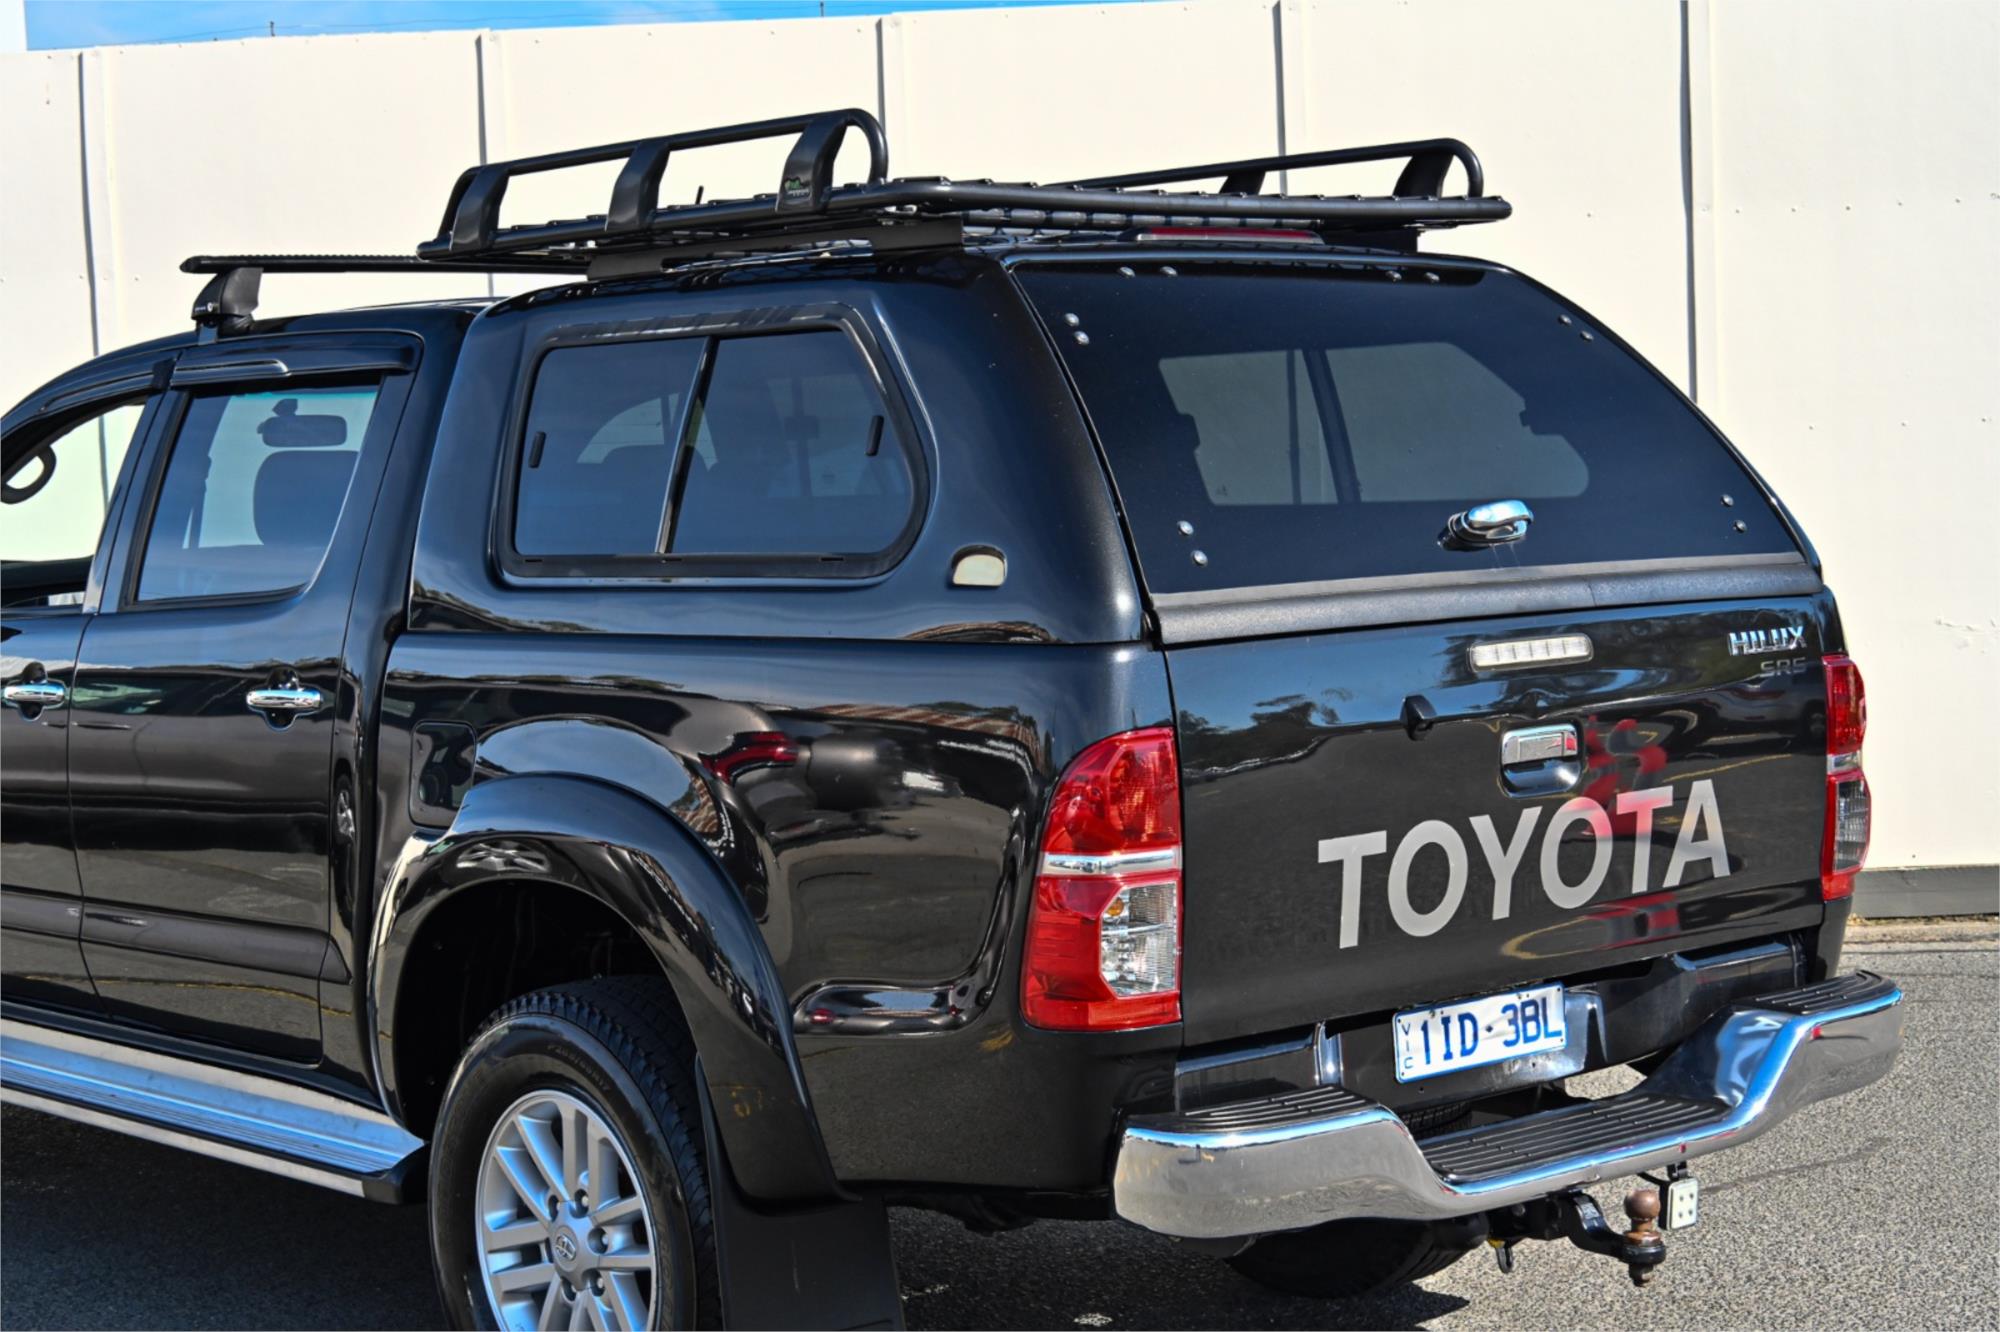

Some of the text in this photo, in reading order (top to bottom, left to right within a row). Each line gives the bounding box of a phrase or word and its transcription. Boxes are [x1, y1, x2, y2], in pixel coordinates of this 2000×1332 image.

[1728, 626, 1807, 656] HILUX
[1318, 778, 1731, 949] TOYOTA
[1401, 1023, 1414, 1070] VIC
